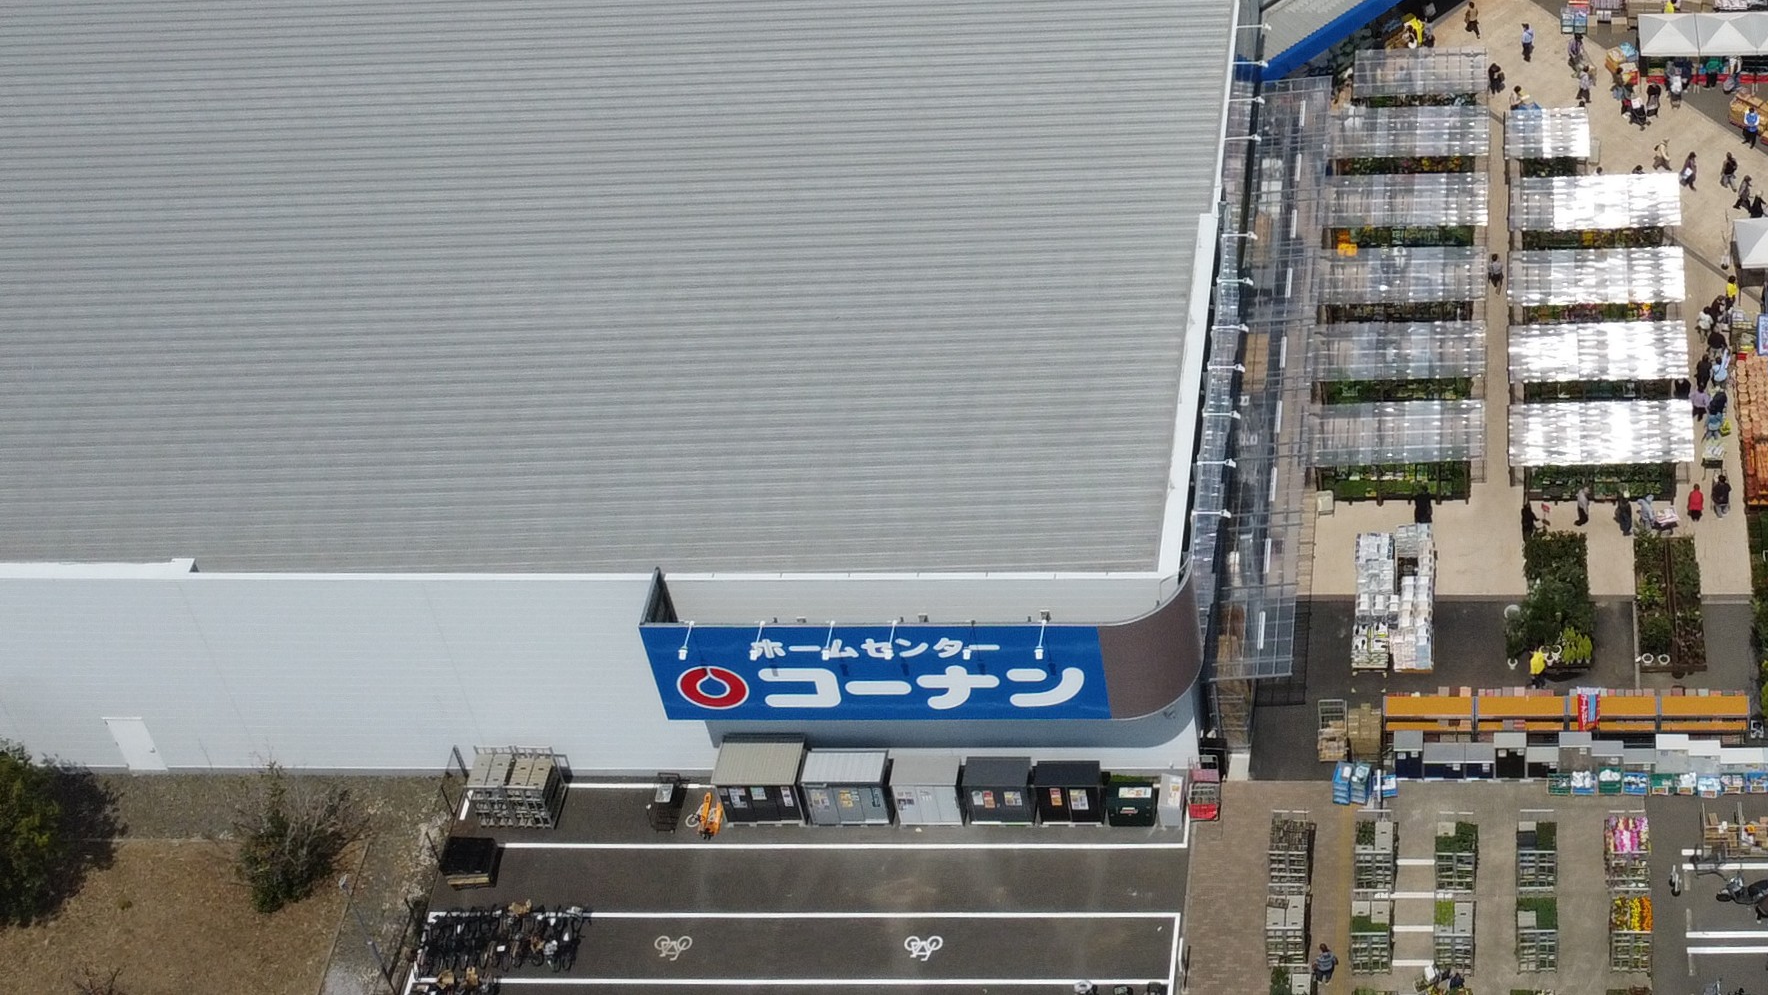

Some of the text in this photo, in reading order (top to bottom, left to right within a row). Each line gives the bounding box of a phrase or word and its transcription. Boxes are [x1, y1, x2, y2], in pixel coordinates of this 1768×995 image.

[750, 635, 1001, 660] ホームセンター
[757, 665, 1085, 710] コーナン
